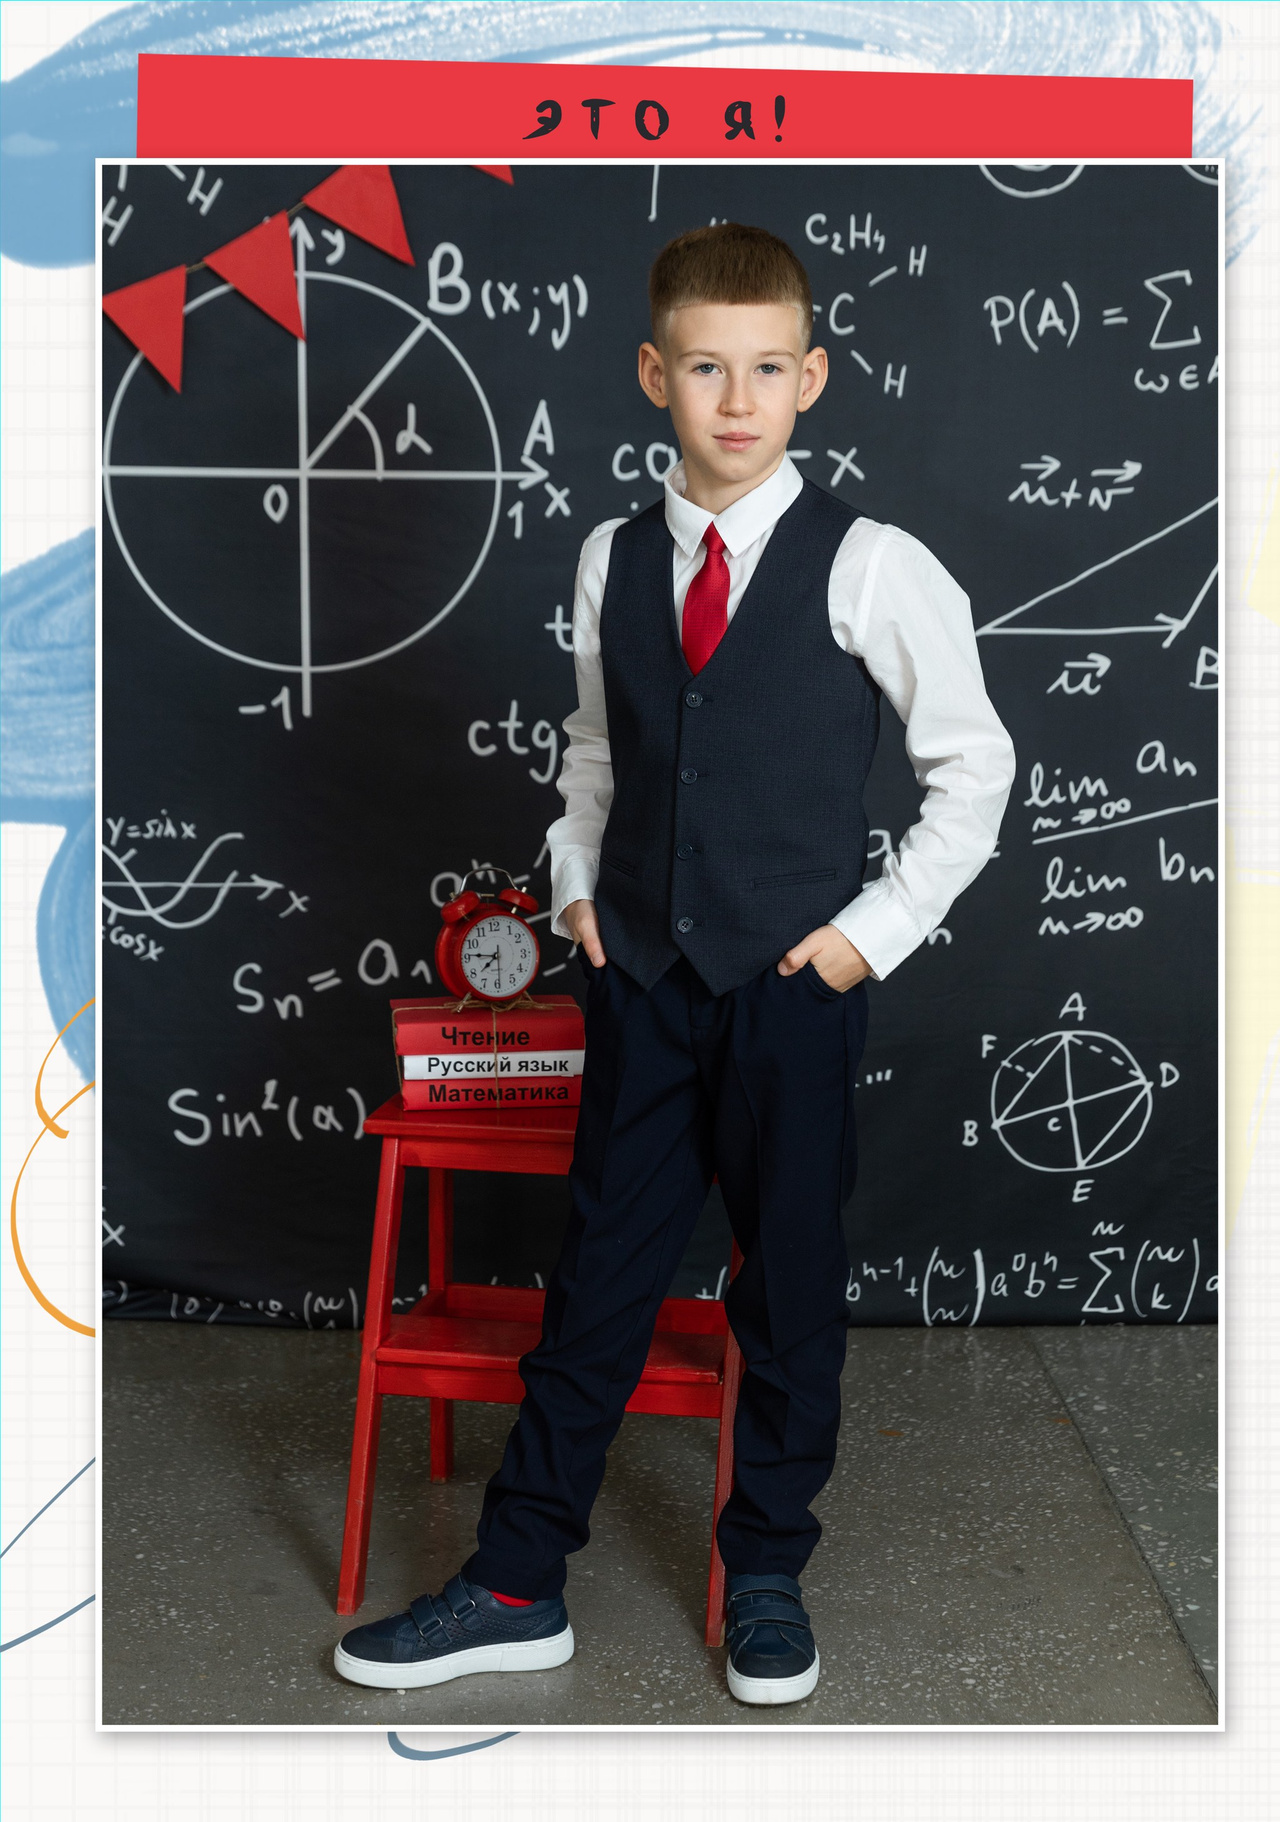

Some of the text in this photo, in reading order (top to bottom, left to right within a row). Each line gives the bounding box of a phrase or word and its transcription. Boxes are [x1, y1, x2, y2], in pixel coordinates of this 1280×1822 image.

[467, 699, 558, 784] ctg
[489, 921, 500, 932] 12
[441, 1026, 531, 1047] Чтение
[427, 1056, 569, 1076] Русский язык
[428, 1084, 570, 1103] Математика
